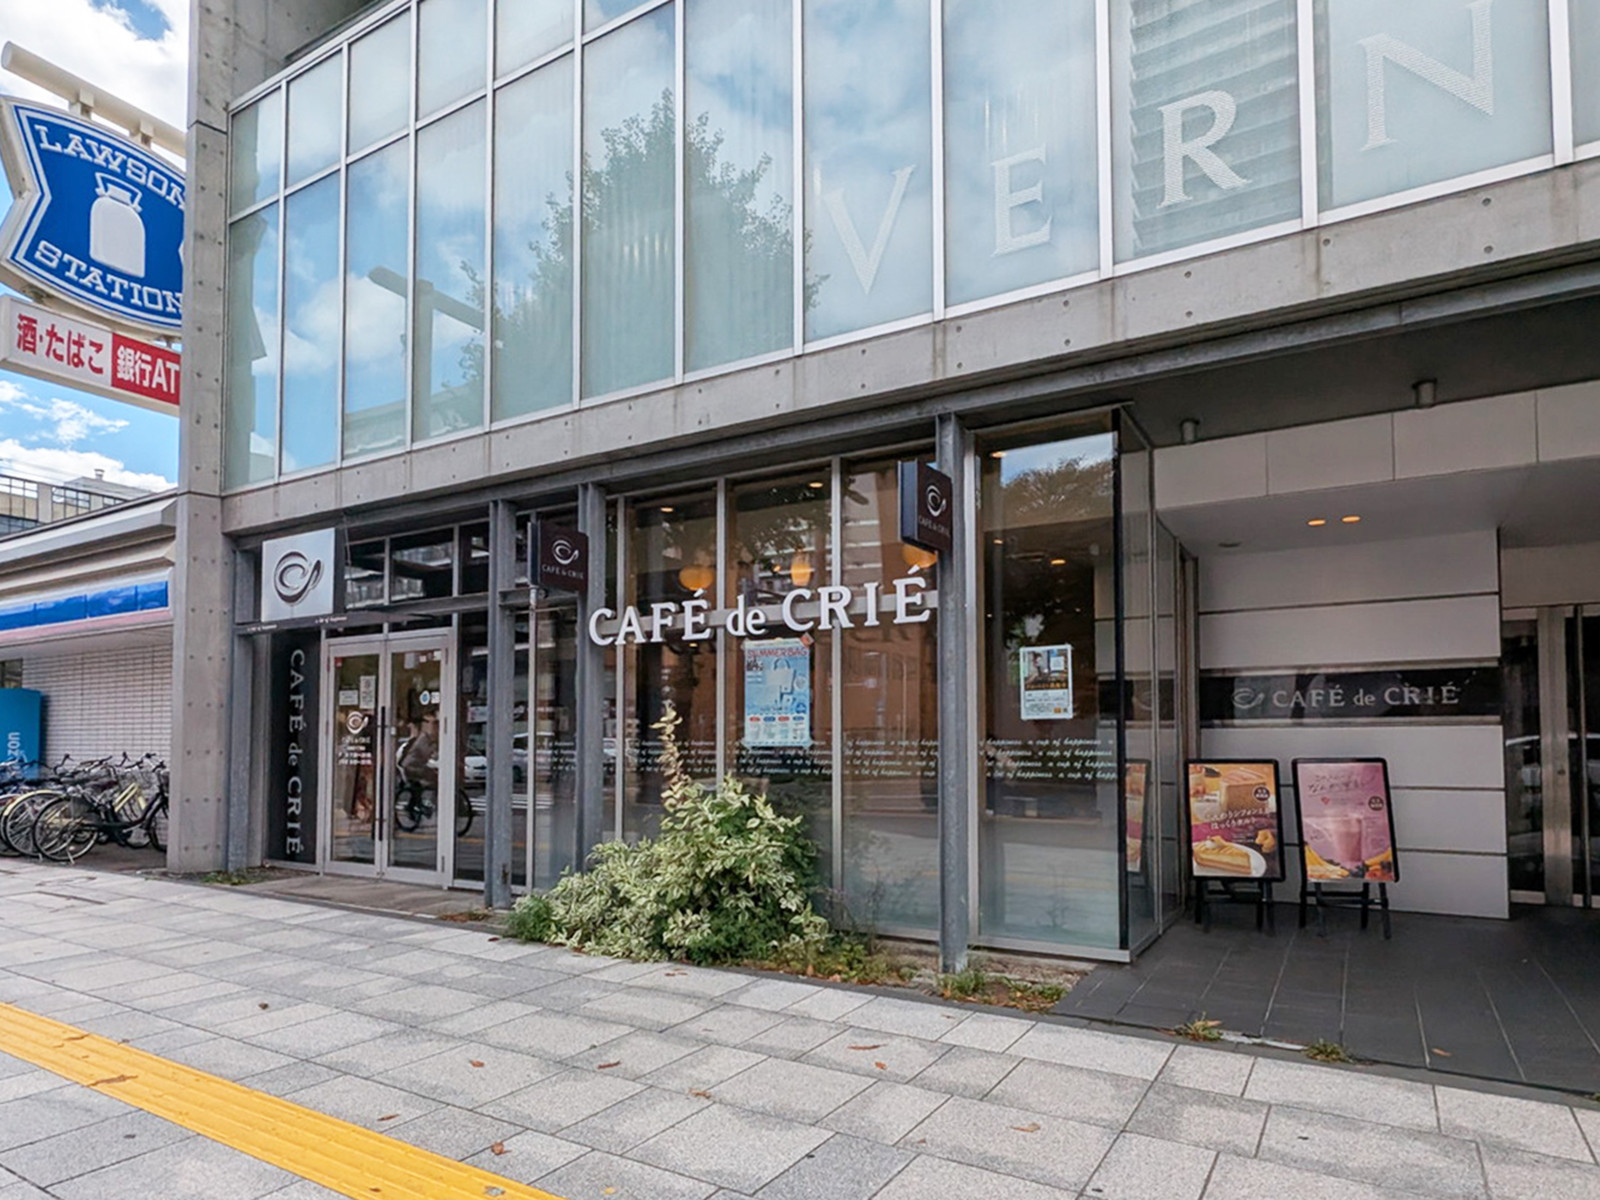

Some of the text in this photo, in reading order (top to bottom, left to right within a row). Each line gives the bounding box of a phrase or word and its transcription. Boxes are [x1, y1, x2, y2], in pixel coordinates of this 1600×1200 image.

[34, 124, 186, 210] LAWSON
[34, 240, 183, 313] STATION
[116, 344, 180, 395] 銀行AT
[589, 565, 931, 647] CAFÉ de CRIÉ
[1272, 682, 1459, 708] CAFÉ de CRIÉ
[286, 649, 305, 856] CAFÉ de CRIÉ
